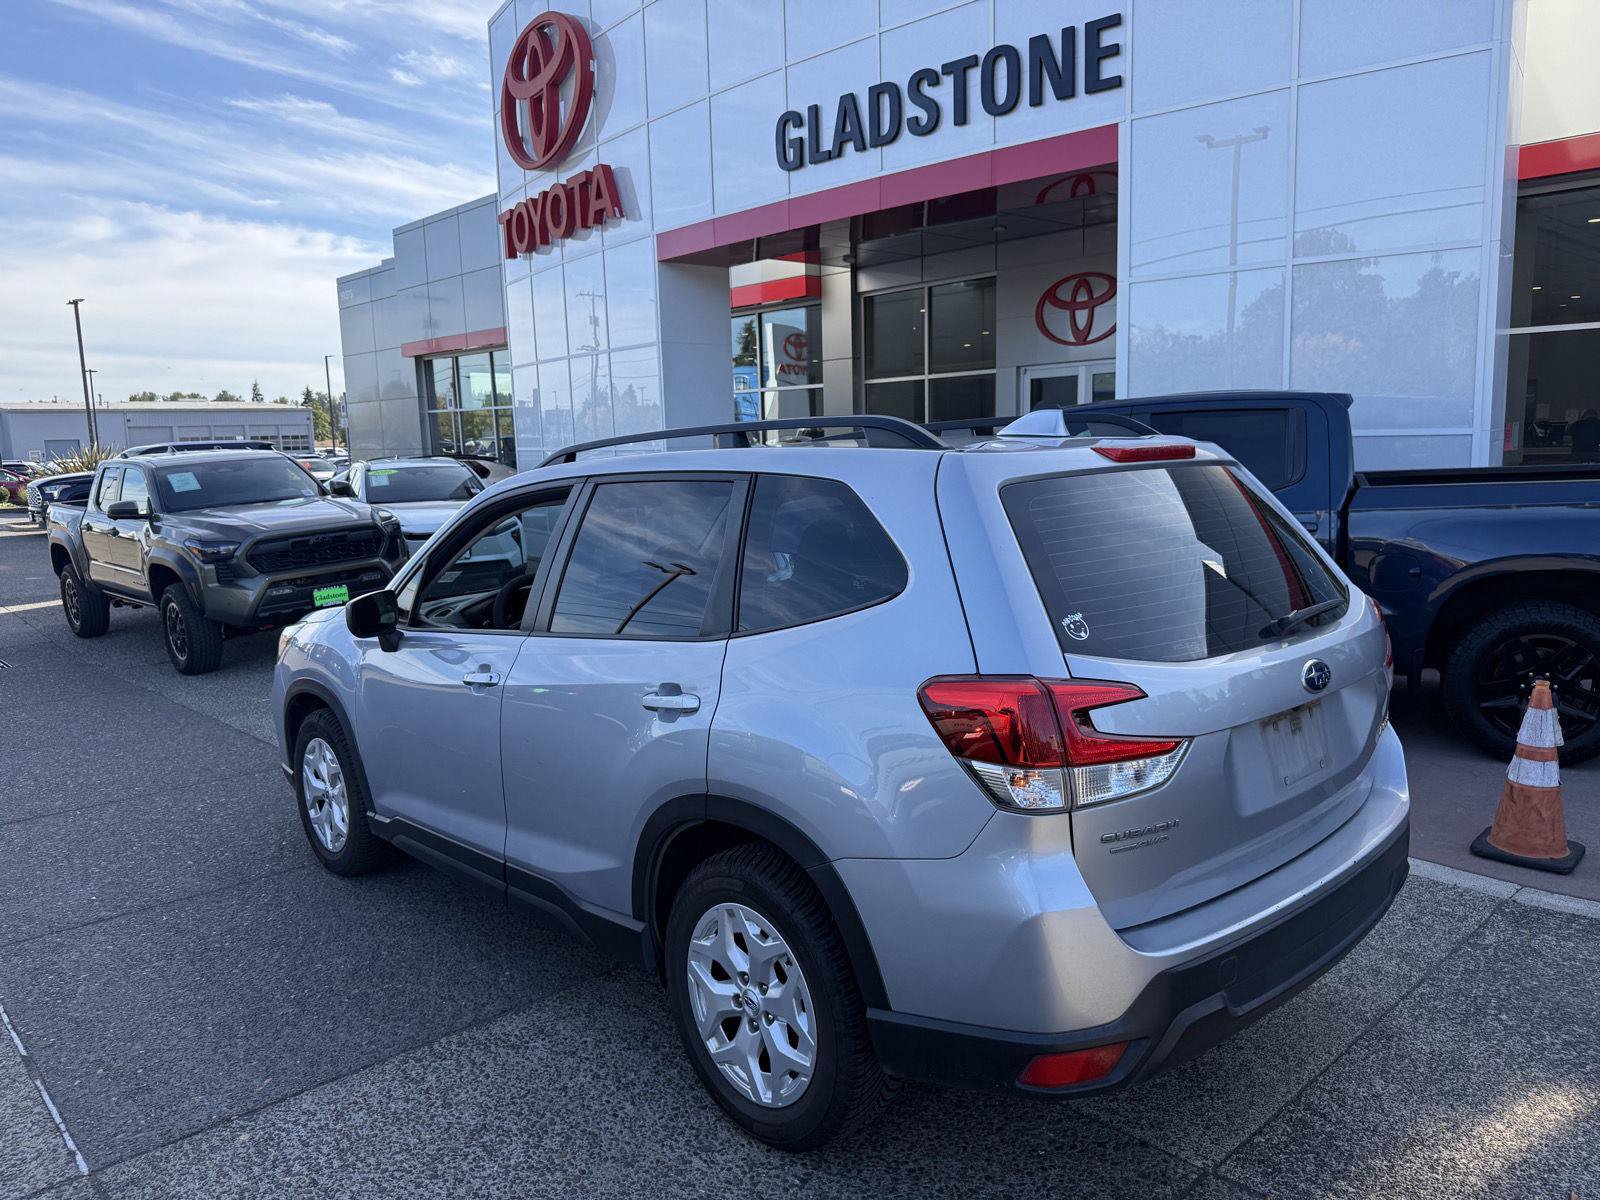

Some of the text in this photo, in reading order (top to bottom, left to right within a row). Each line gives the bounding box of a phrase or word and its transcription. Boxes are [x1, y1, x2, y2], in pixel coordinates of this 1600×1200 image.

[776, 13, 1122, 172] GLADSTONE
[498, 163, 623, 259] TOYOTA
[1101, 819, 1180, 844] SUBARU
